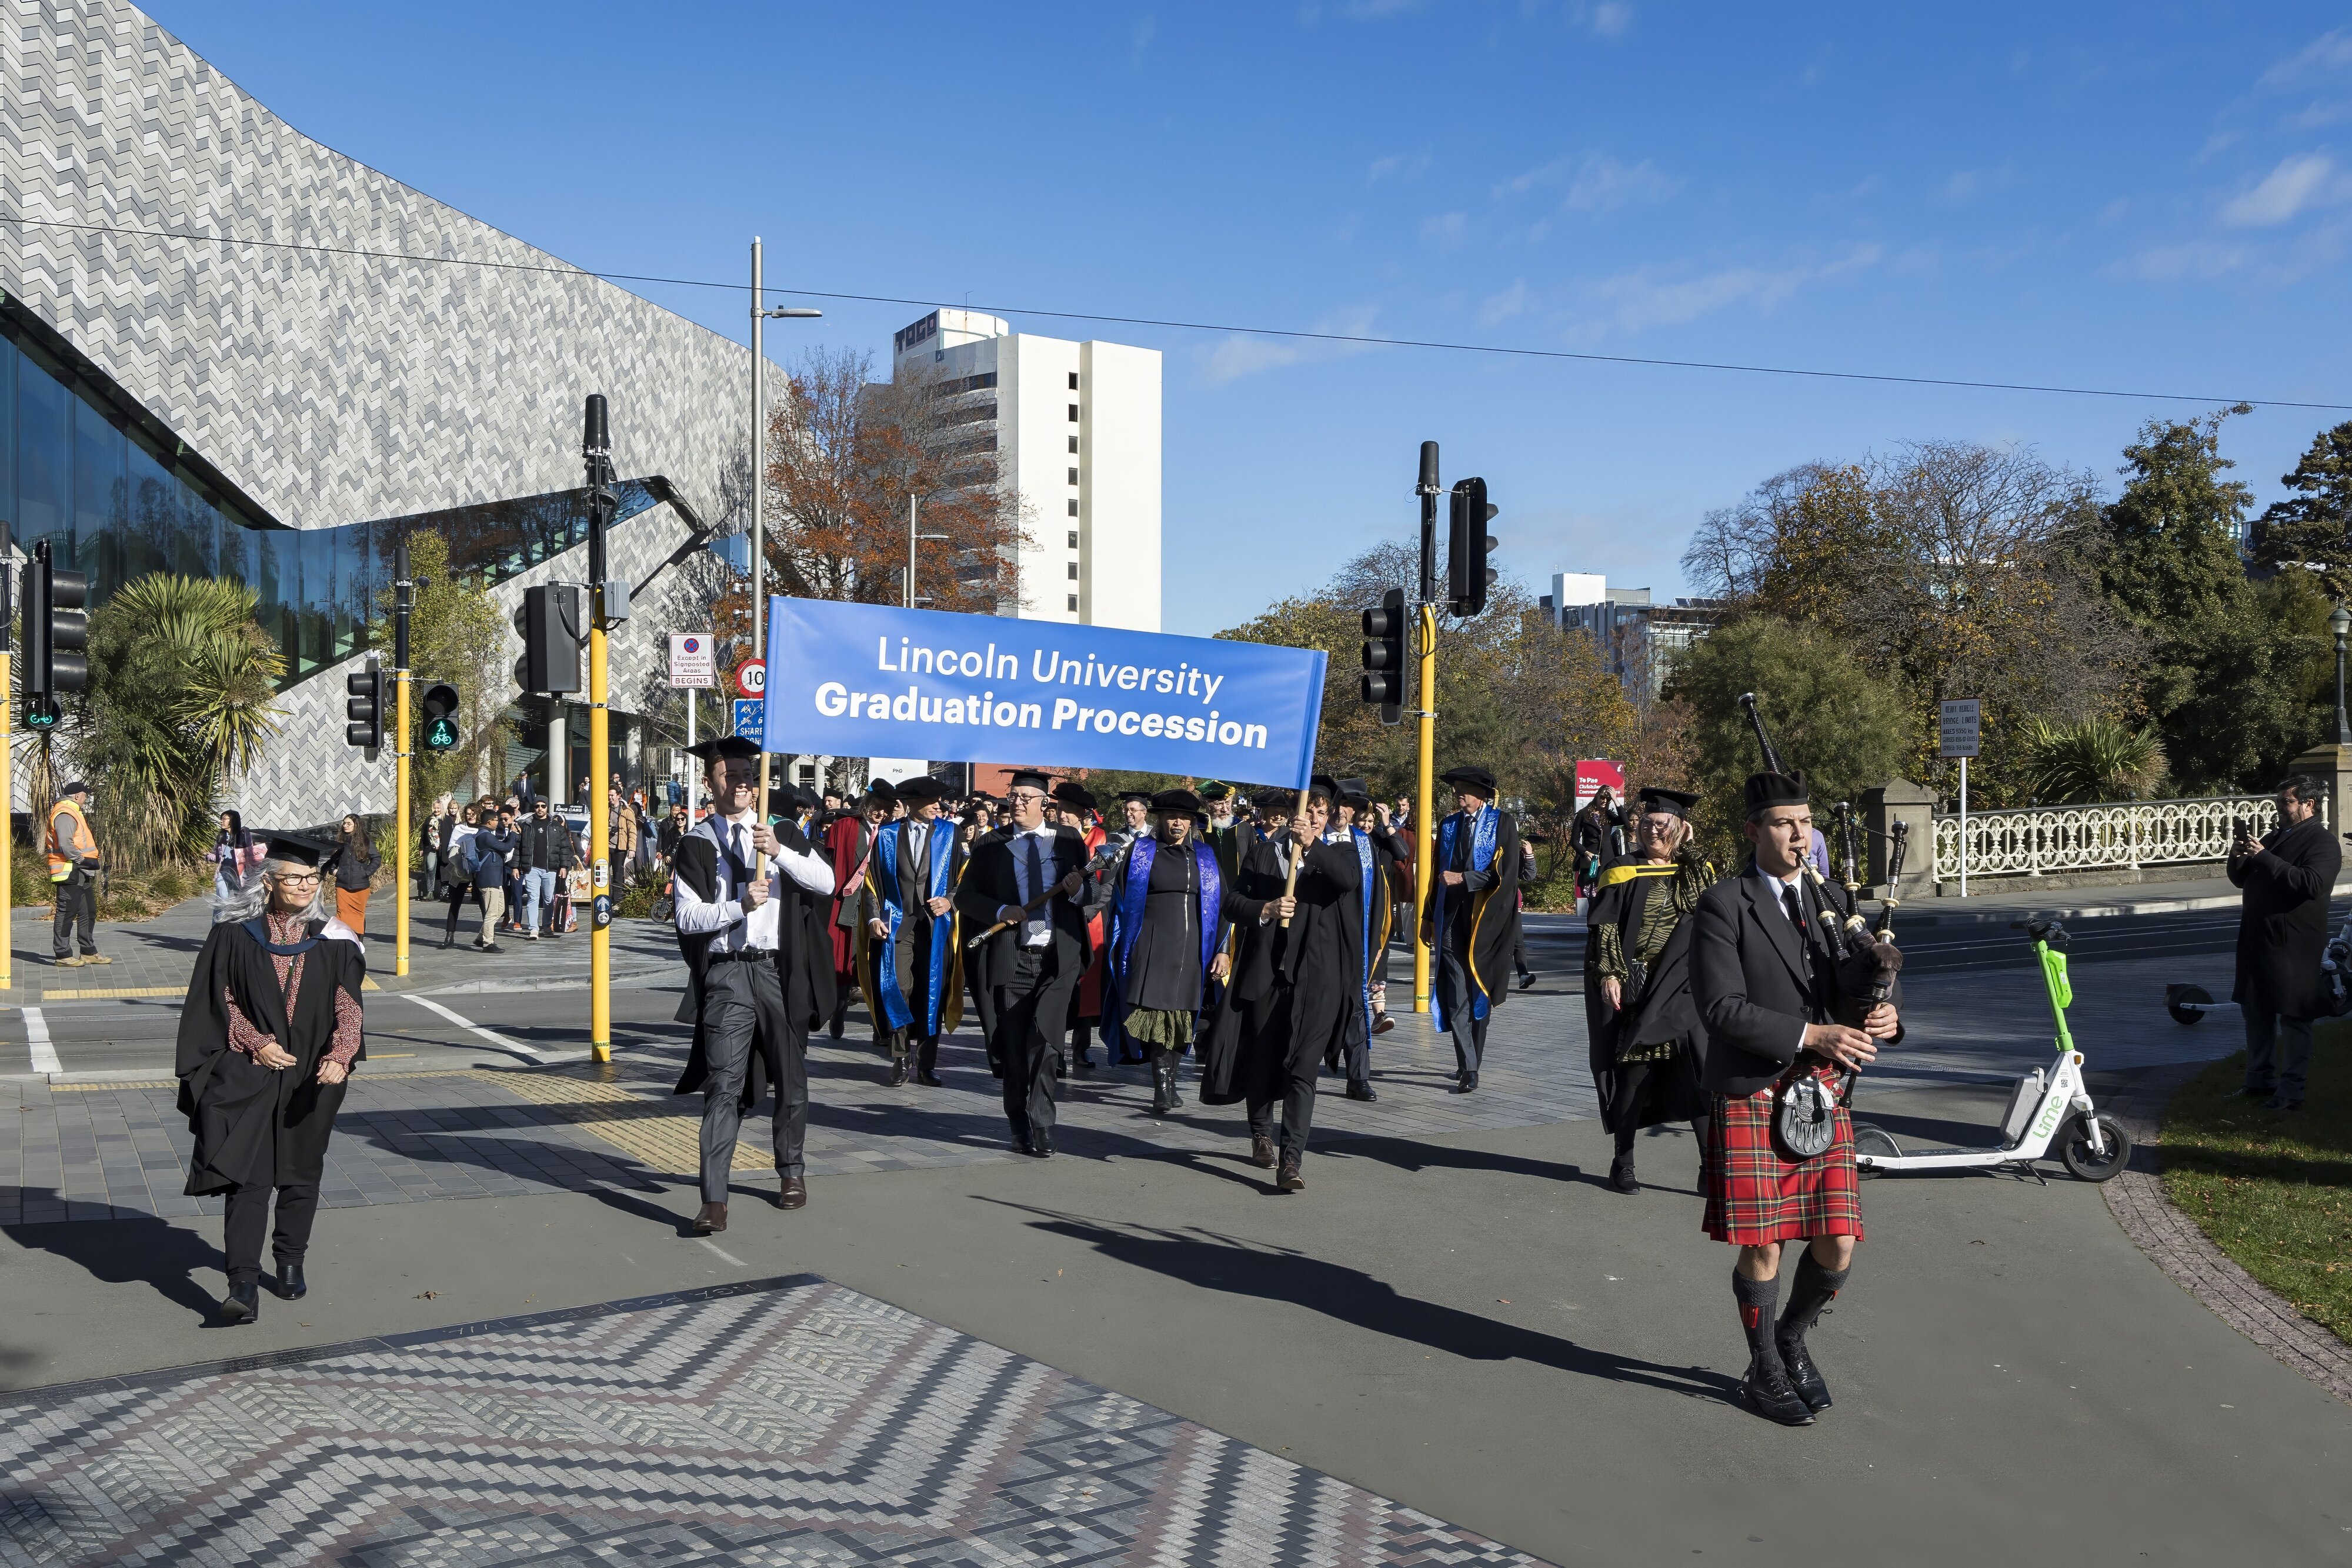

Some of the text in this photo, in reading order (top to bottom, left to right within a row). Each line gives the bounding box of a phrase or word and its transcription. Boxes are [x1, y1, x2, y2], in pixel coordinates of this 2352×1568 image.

[748, 671, 765, 686] 10
[878, 636, 1224, 705] Lincoln University
[814, 681, 1267, 750] Graduation Procession
[2032, 1096, 2063, 1139] Lime
